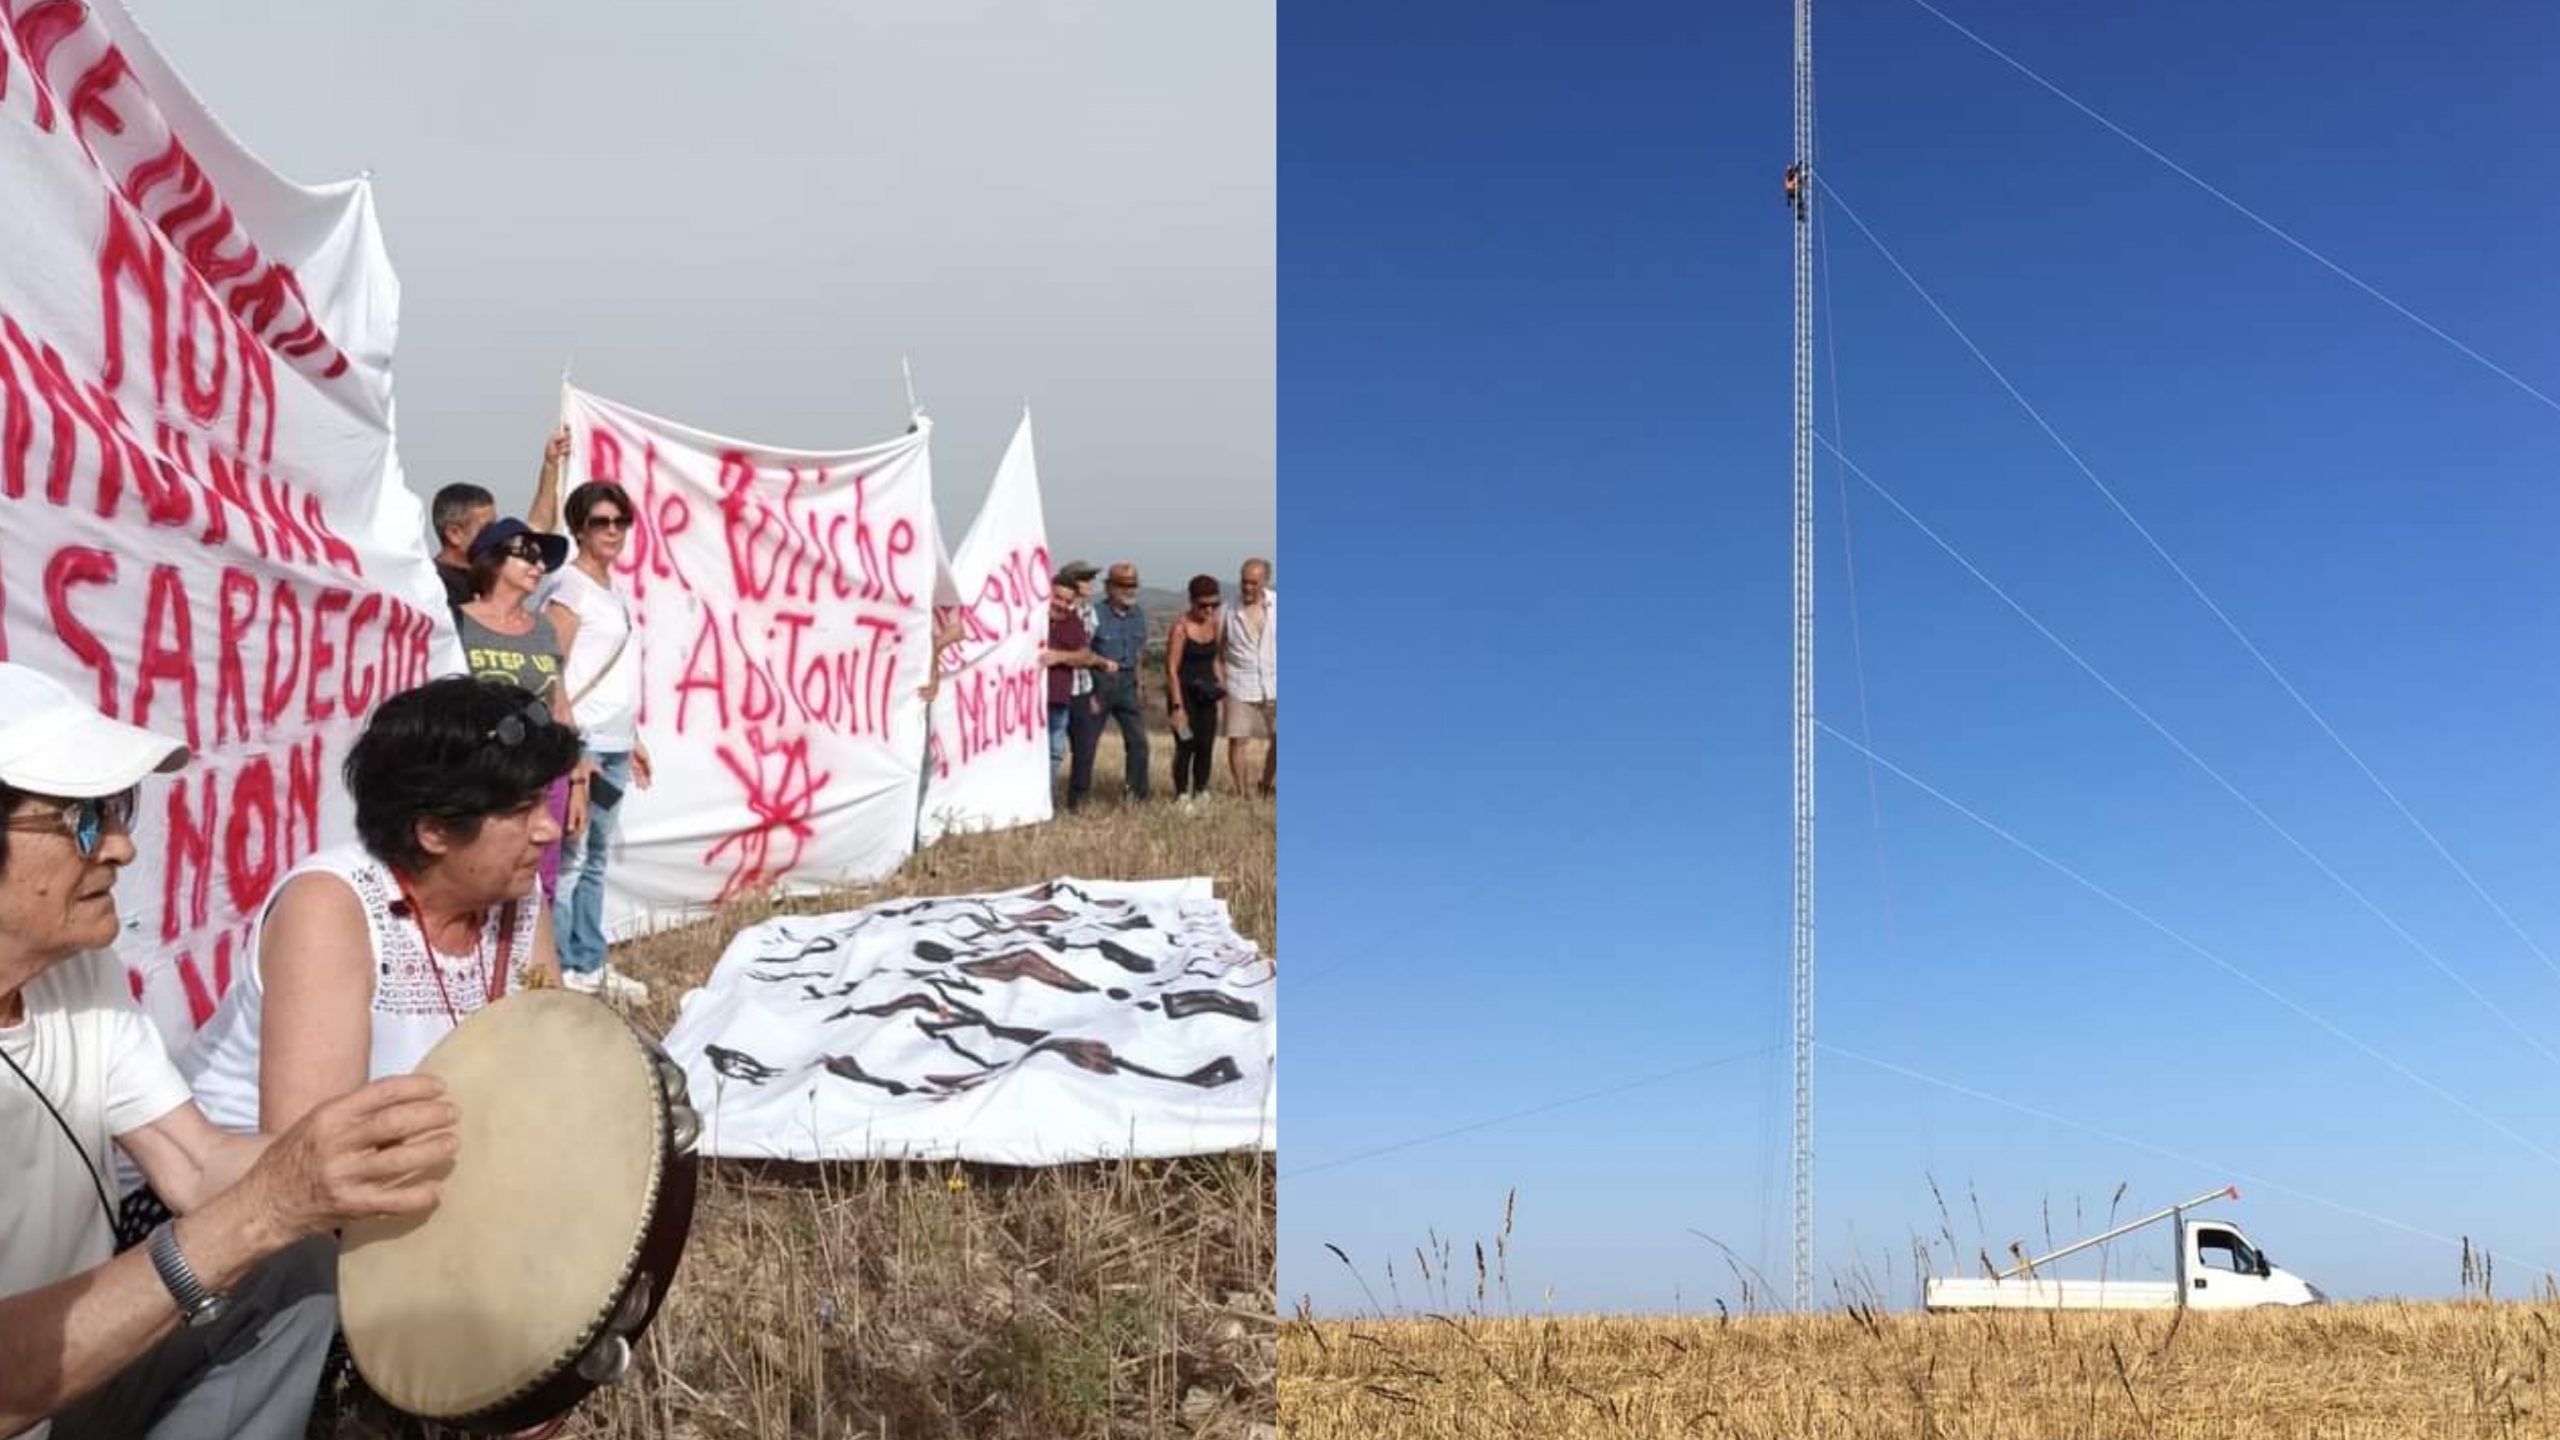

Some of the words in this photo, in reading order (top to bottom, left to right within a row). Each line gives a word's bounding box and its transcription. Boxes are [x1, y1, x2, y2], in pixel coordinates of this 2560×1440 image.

[97, 190, 277, 465] NON
[44, 545, 435, 758] SARDEGNA
[469, 649, 526, 672] STEP
[161, 733, 323, 945] NON
